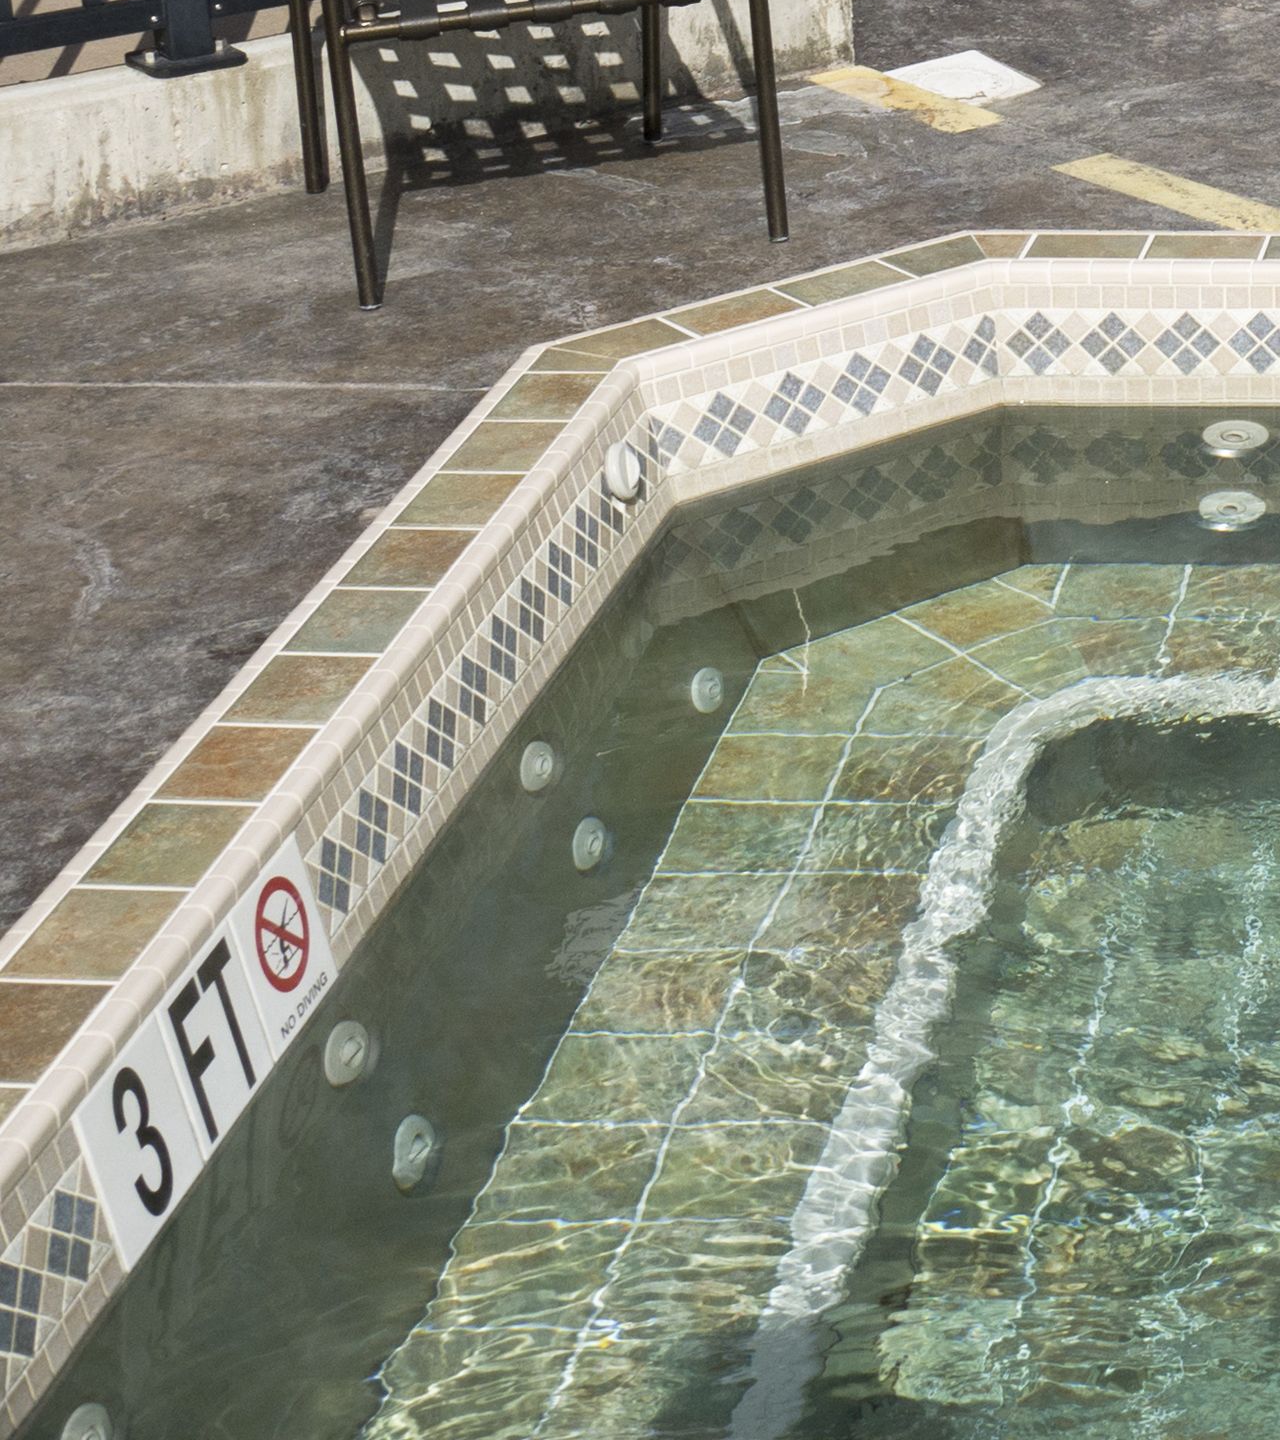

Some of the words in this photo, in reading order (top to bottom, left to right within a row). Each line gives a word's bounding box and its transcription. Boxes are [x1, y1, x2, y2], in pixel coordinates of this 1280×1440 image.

[112, 1066, 174, 1217] 3
[168, 936, 257, 1144] FT
[281, 1014, 297, 1039] NO
[296, 971, 328, 1018] DIVING
